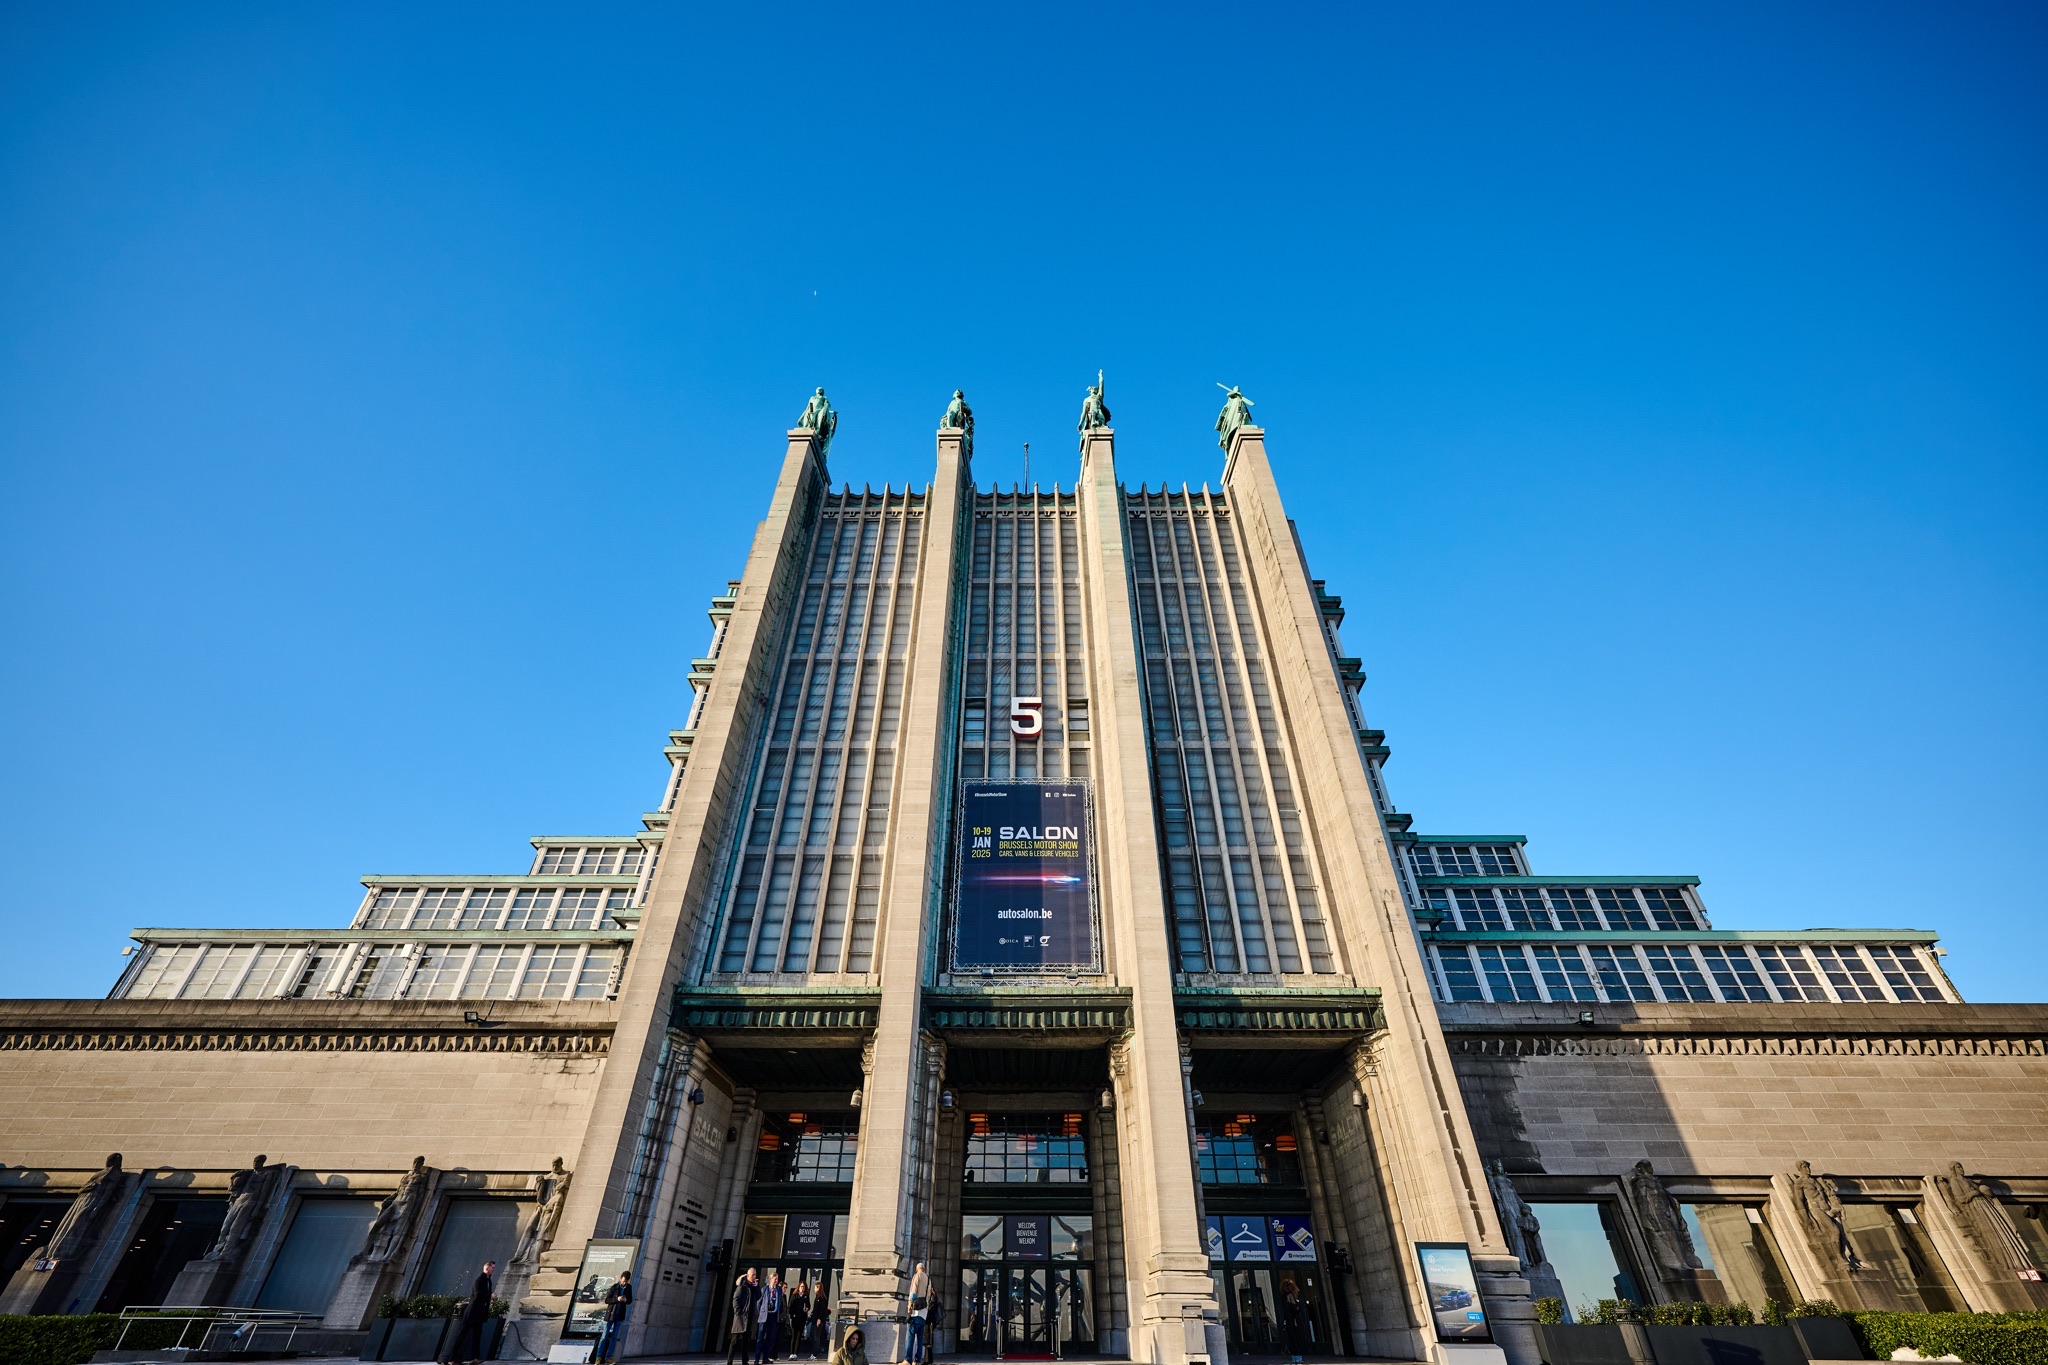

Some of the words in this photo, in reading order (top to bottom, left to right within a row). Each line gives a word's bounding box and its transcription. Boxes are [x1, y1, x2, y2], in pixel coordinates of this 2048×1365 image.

[1011, 697, 1042, 735] 5
[1000, 826, 1078, 840] SALON
[972, 836, 991, 848] JAN
[1000, 841, 1032, 849] BRUSSELS
[1034, 841, 1057, 849] MOTOR
[1058, 841, 1078, 849] SHOW
[998, 908, 1052, 918] autosalon.be
